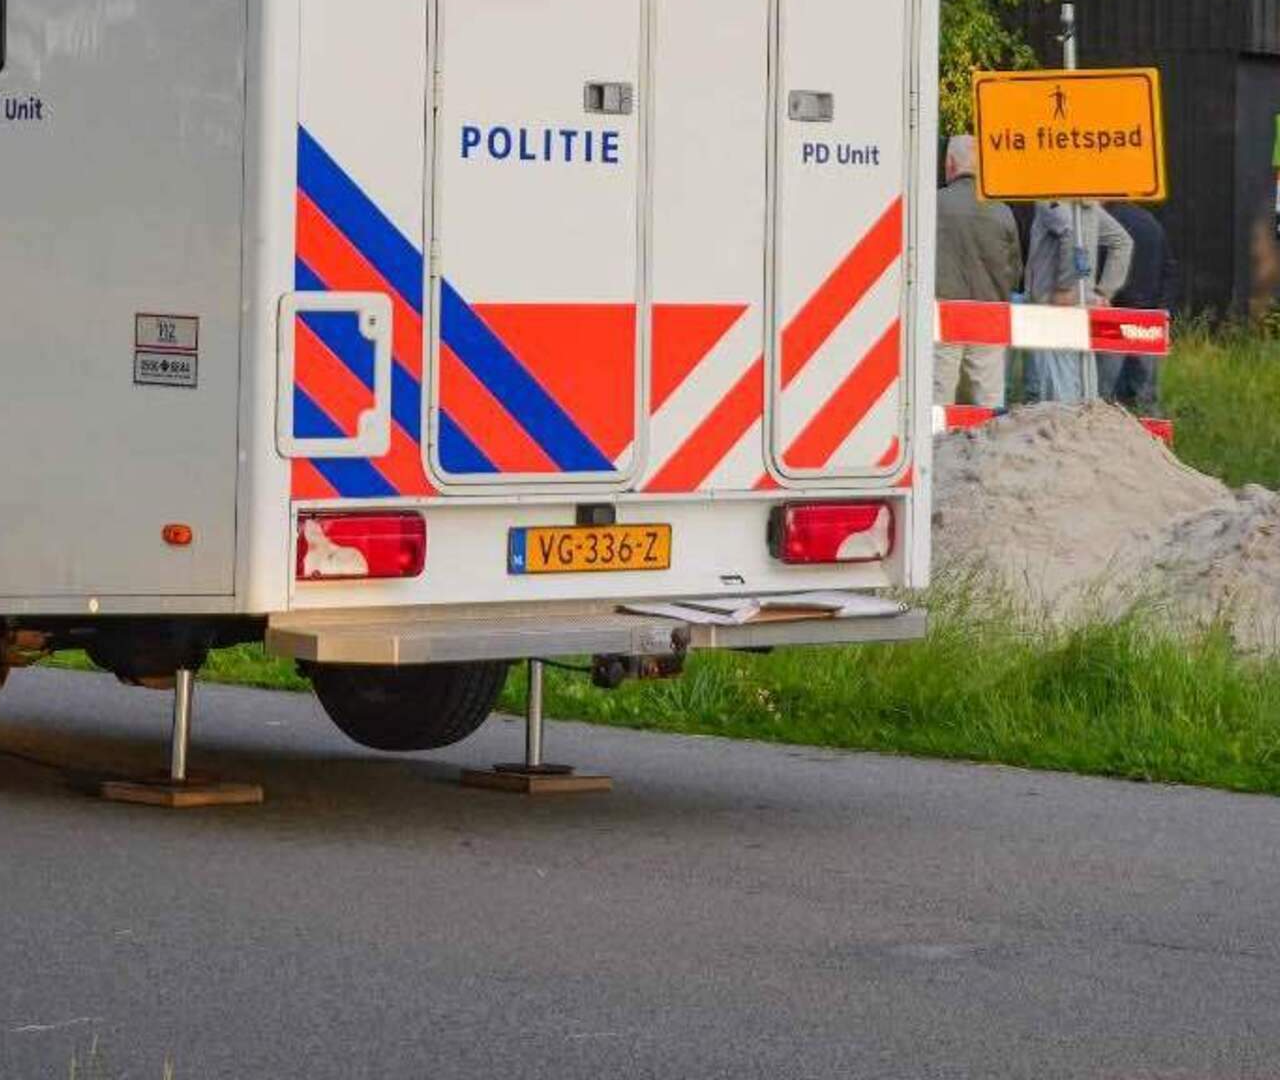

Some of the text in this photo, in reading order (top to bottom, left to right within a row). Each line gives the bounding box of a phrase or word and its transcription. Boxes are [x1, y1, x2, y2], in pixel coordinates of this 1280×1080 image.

[6, 97, 43, 121] Unit
[460, 125, 620, 164] POLITIE
[802, 142, 880, 166] PD Unit
[989, 124, 1143, 154] via fietspad
[539, 531, 658, 565] VG-336-Z
